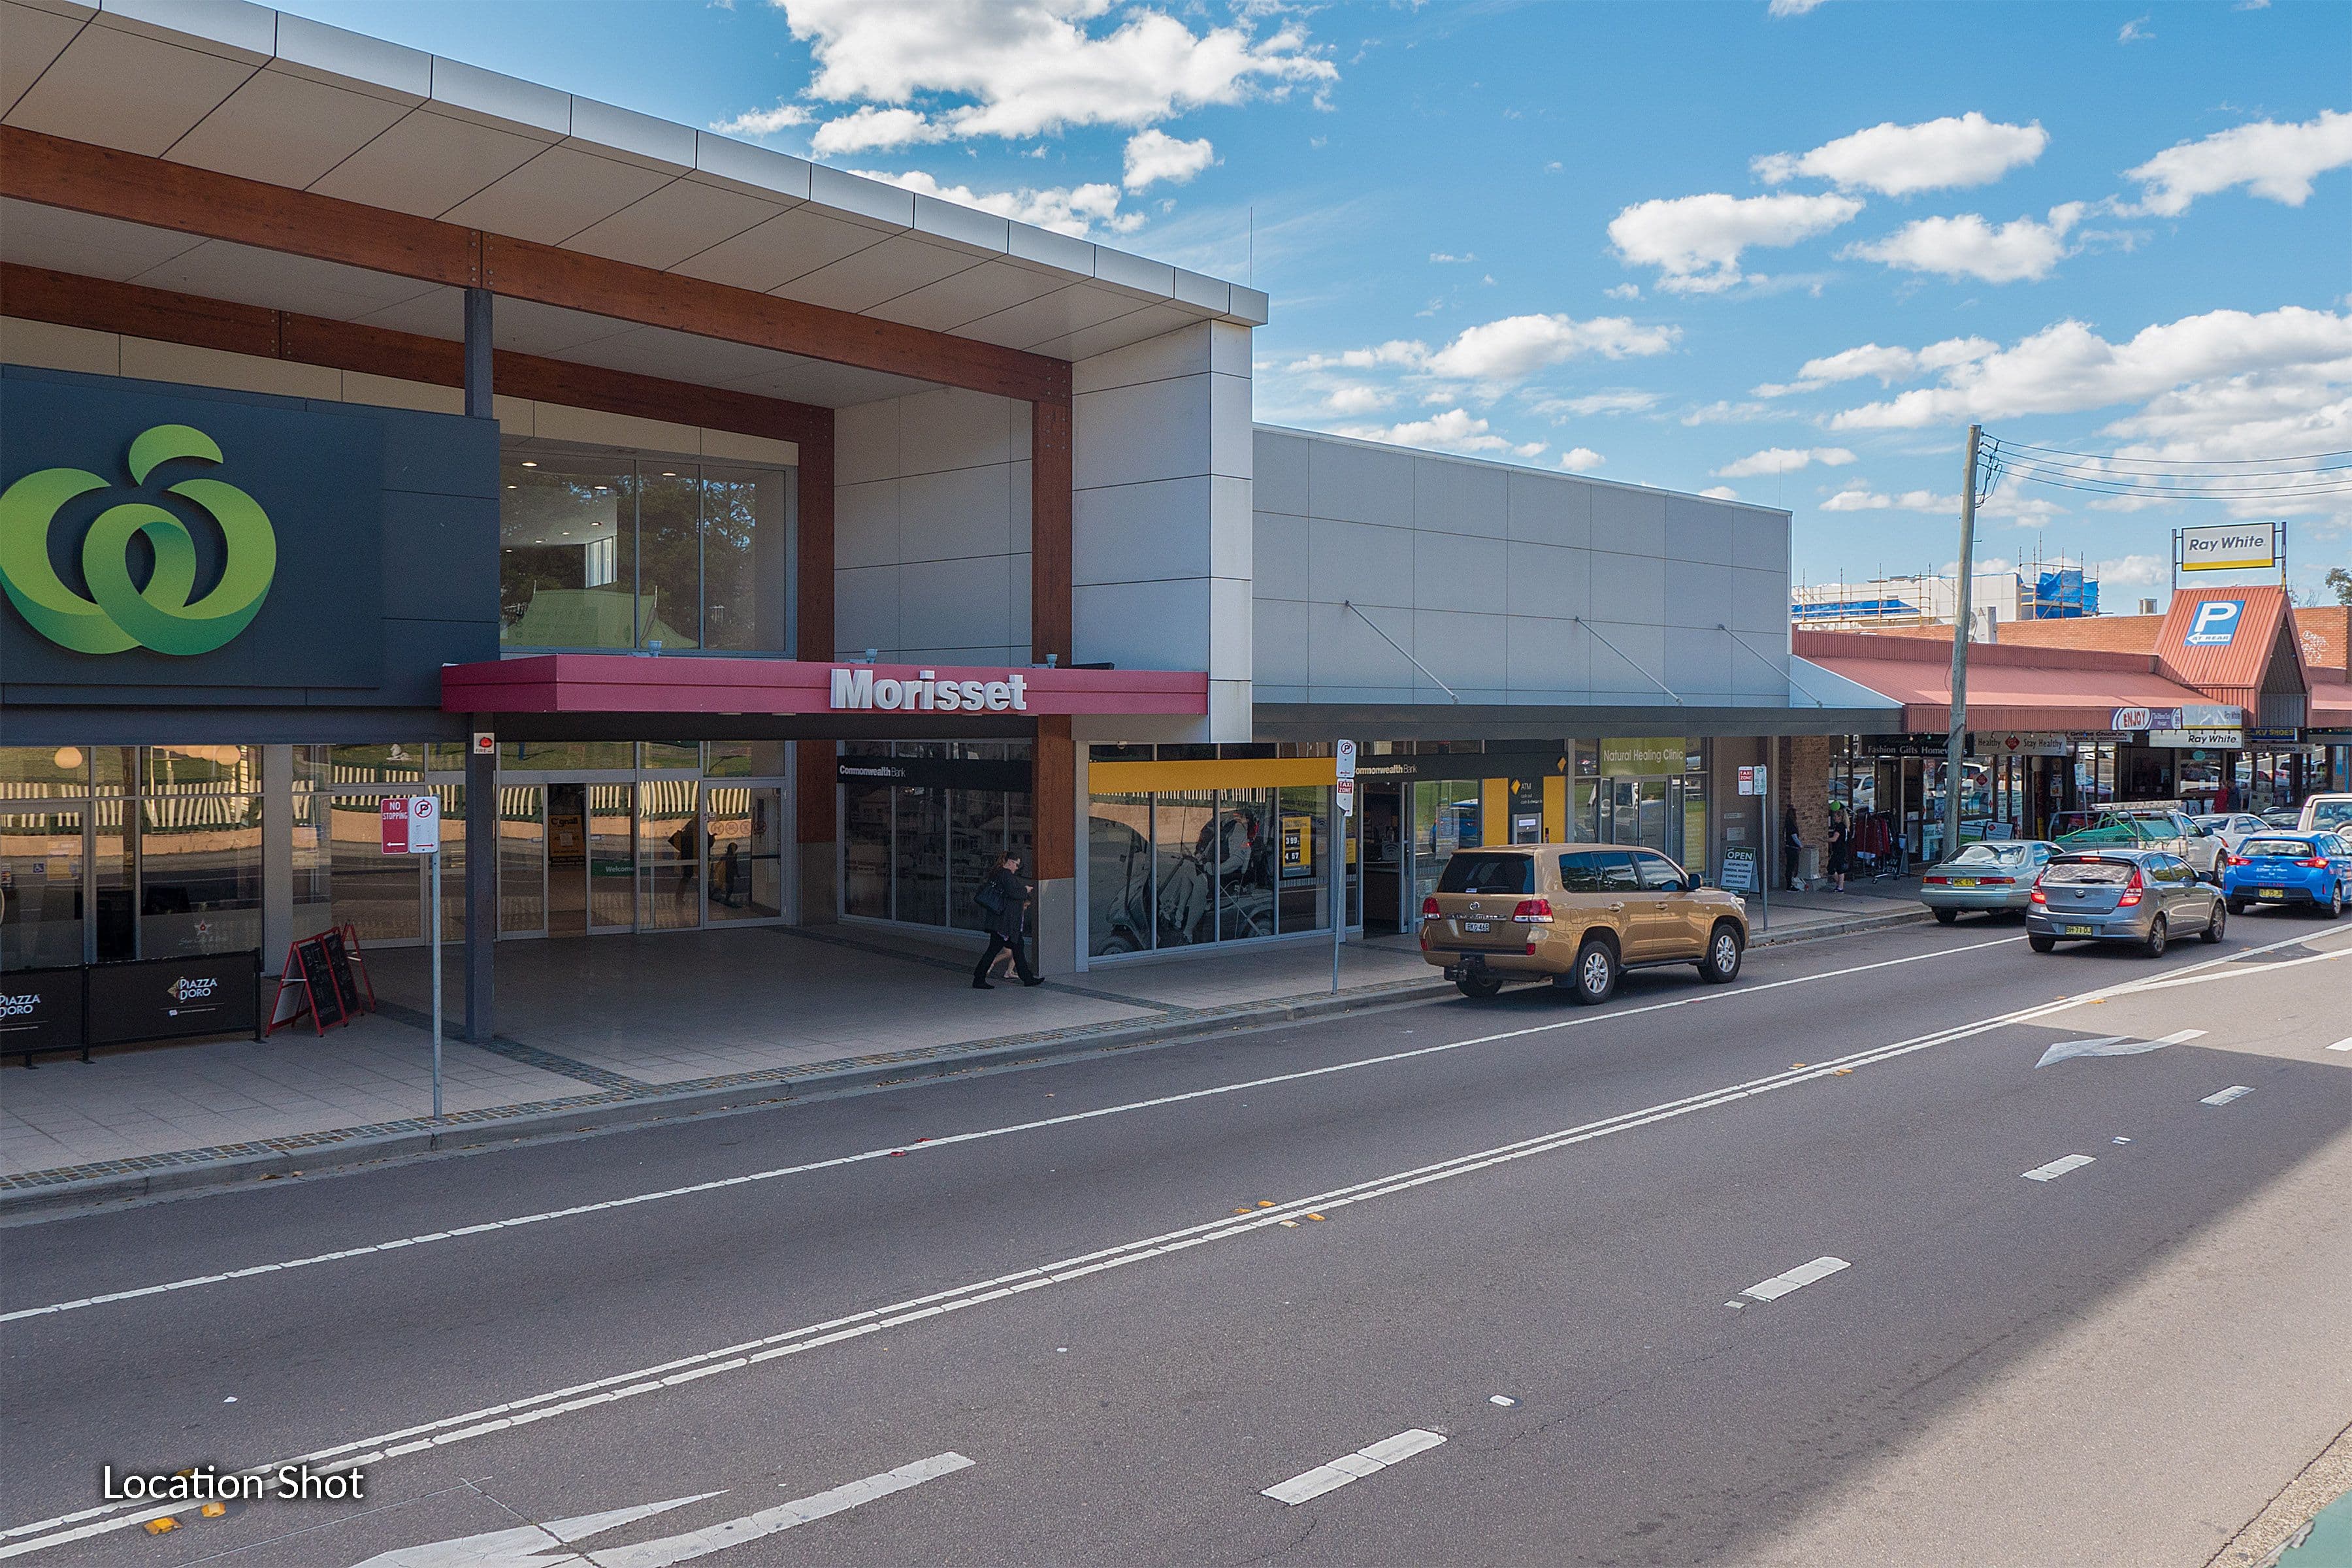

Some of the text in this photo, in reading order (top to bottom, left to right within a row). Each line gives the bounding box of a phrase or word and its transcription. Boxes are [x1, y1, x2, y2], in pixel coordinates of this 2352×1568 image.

[2189, 535, 2264, 552] Ray White
[2194, 602, 2237, 632] P
[830, 668, 1027, 710] Morisset
[2123, 710, 2146, 728] ENJOY
[1978, 739, 2063, 749] Healthy Stay Healthy
[2188, 735, 2207, 744] Ray
[1604, 749, 1684, 763] Natural Healing Clinic
[1354, 764, 1403, 775] ommonwealth
[389, 802, 400, 810] NO
[1727, 851, 1752, 860] OPEN
[180, 979, 218, 989] PIAZZA
